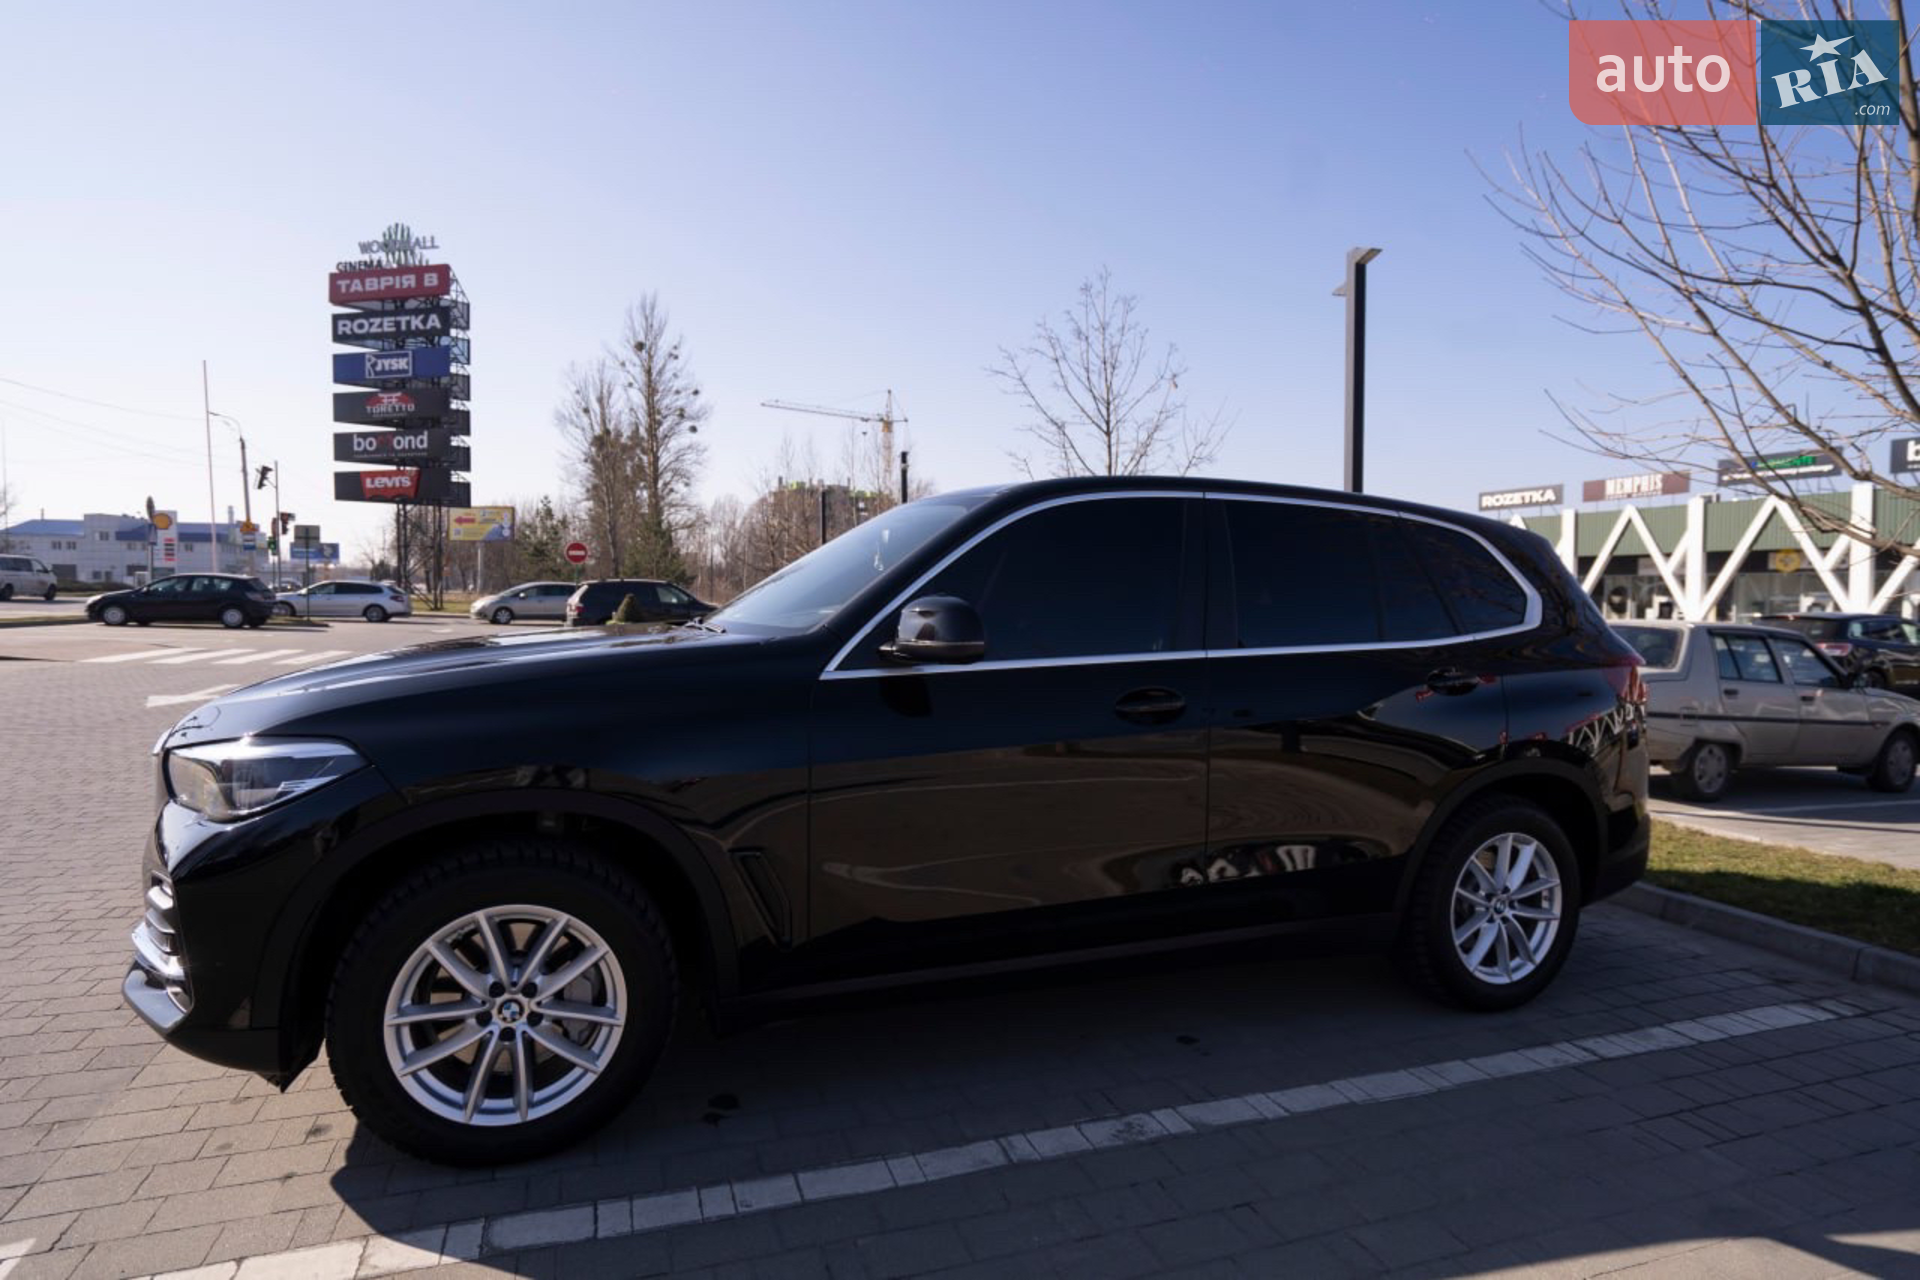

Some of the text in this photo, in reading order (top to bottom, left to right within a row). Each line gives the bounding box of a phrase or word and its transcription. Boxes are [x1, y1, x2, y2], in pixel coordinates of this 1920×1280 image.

[336, 258, 383, 272] CINEMA
[336, 273, 439, 293] ТАВРІЯ В
[336, 313, 442, 336] ROZETKA
[375, 357, 409, 371] JYSK
[366, 403, 416, 415] TORETTO
[1605, 473, 1663, 495] MEMPHIS
[1481, 489, 1557, 508] ROZETKA
